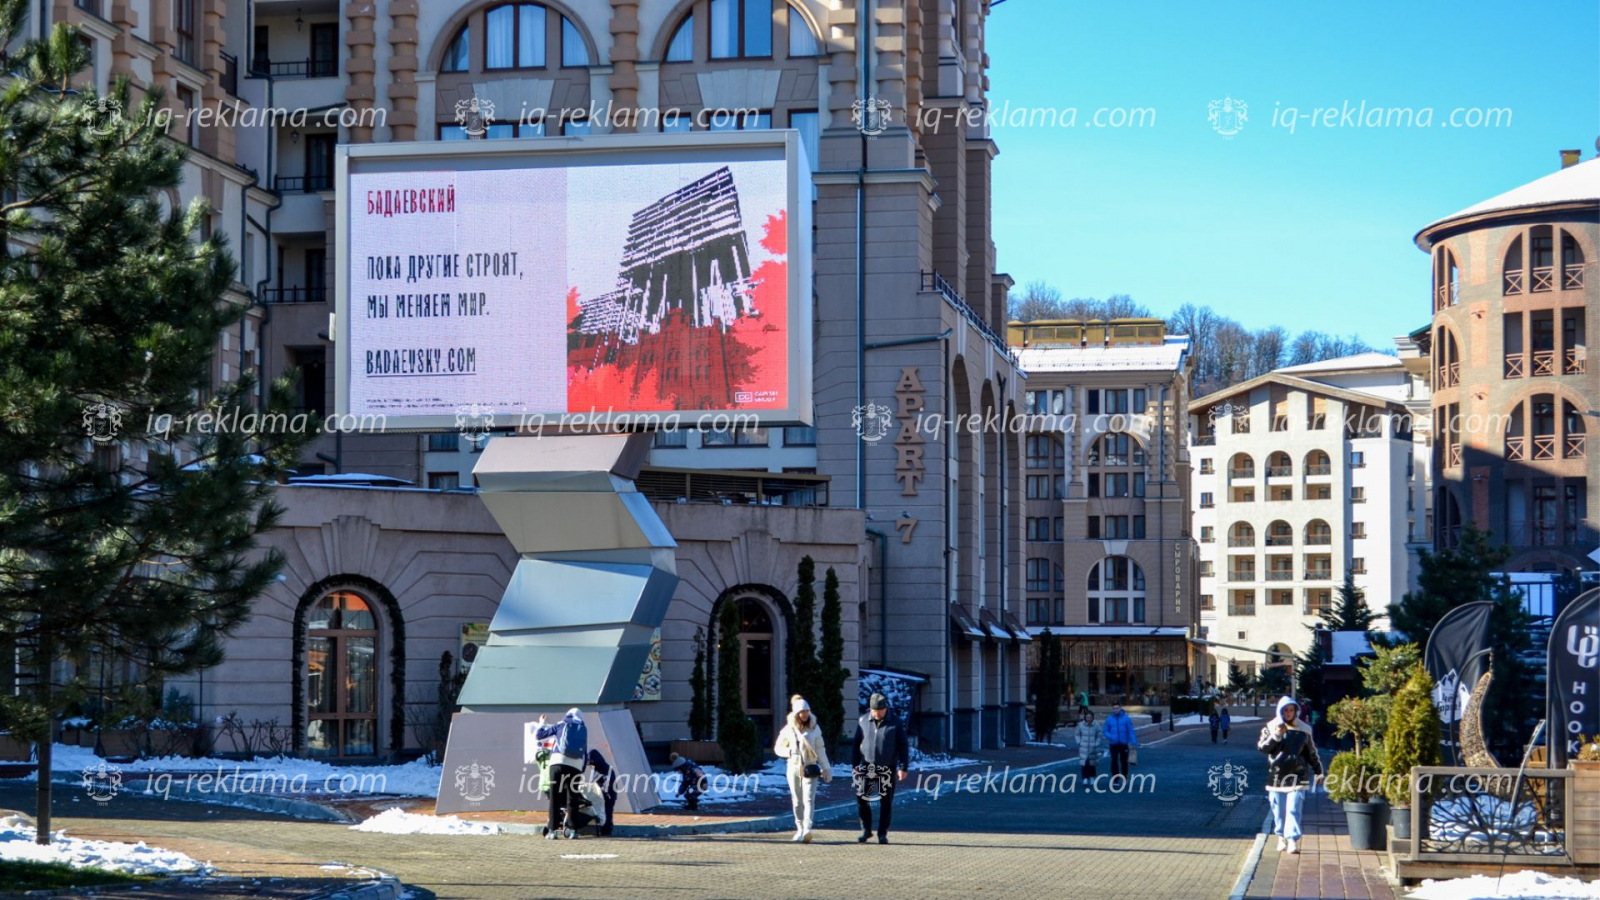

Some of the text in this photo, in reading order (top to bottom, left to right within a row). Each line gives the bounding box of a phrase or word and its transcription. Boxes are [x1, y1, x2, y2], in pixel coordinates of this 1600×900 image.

[367, 184, 456, 218] БАДАЕВСКИЙ
[367, 251, 523, 283] ПОКА ДРУГИЕ СТРОЯТ,
[367, 291, 490, 319] МЫ МЕНЯЕМ МИР.
[366, 347, 477, 375] BADAEVSKY.COM
[894, 366, 927, 544] APART 7
